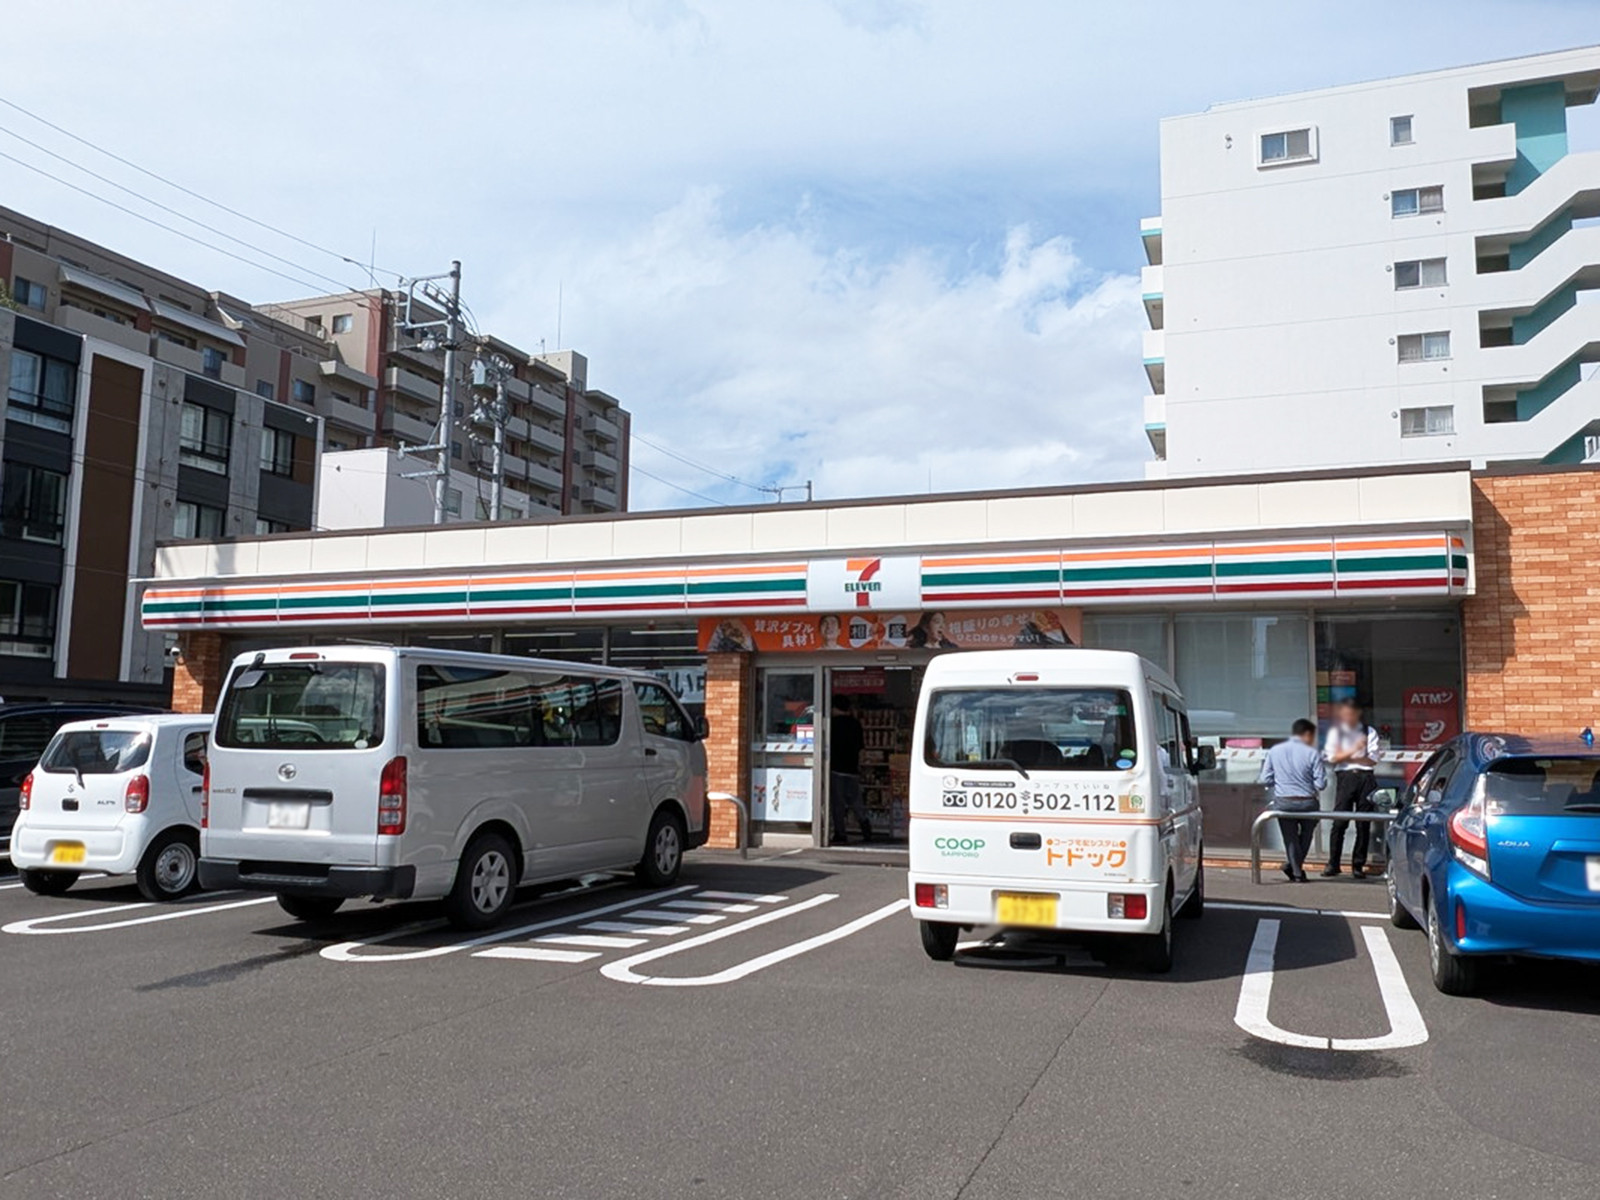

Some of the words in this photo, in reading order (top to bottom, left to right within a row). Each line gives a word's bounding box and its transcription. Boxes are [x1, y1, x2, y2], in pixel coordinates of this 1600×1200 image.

[754, 618, 814, 633] 贅沢ダブル
[972, 791, 1017, 809] 0120
[1033, 793, 1116, 811] 502-112
[934, 837, 986, 850] COOP
[1046, 847, 1127, 869] トドック
